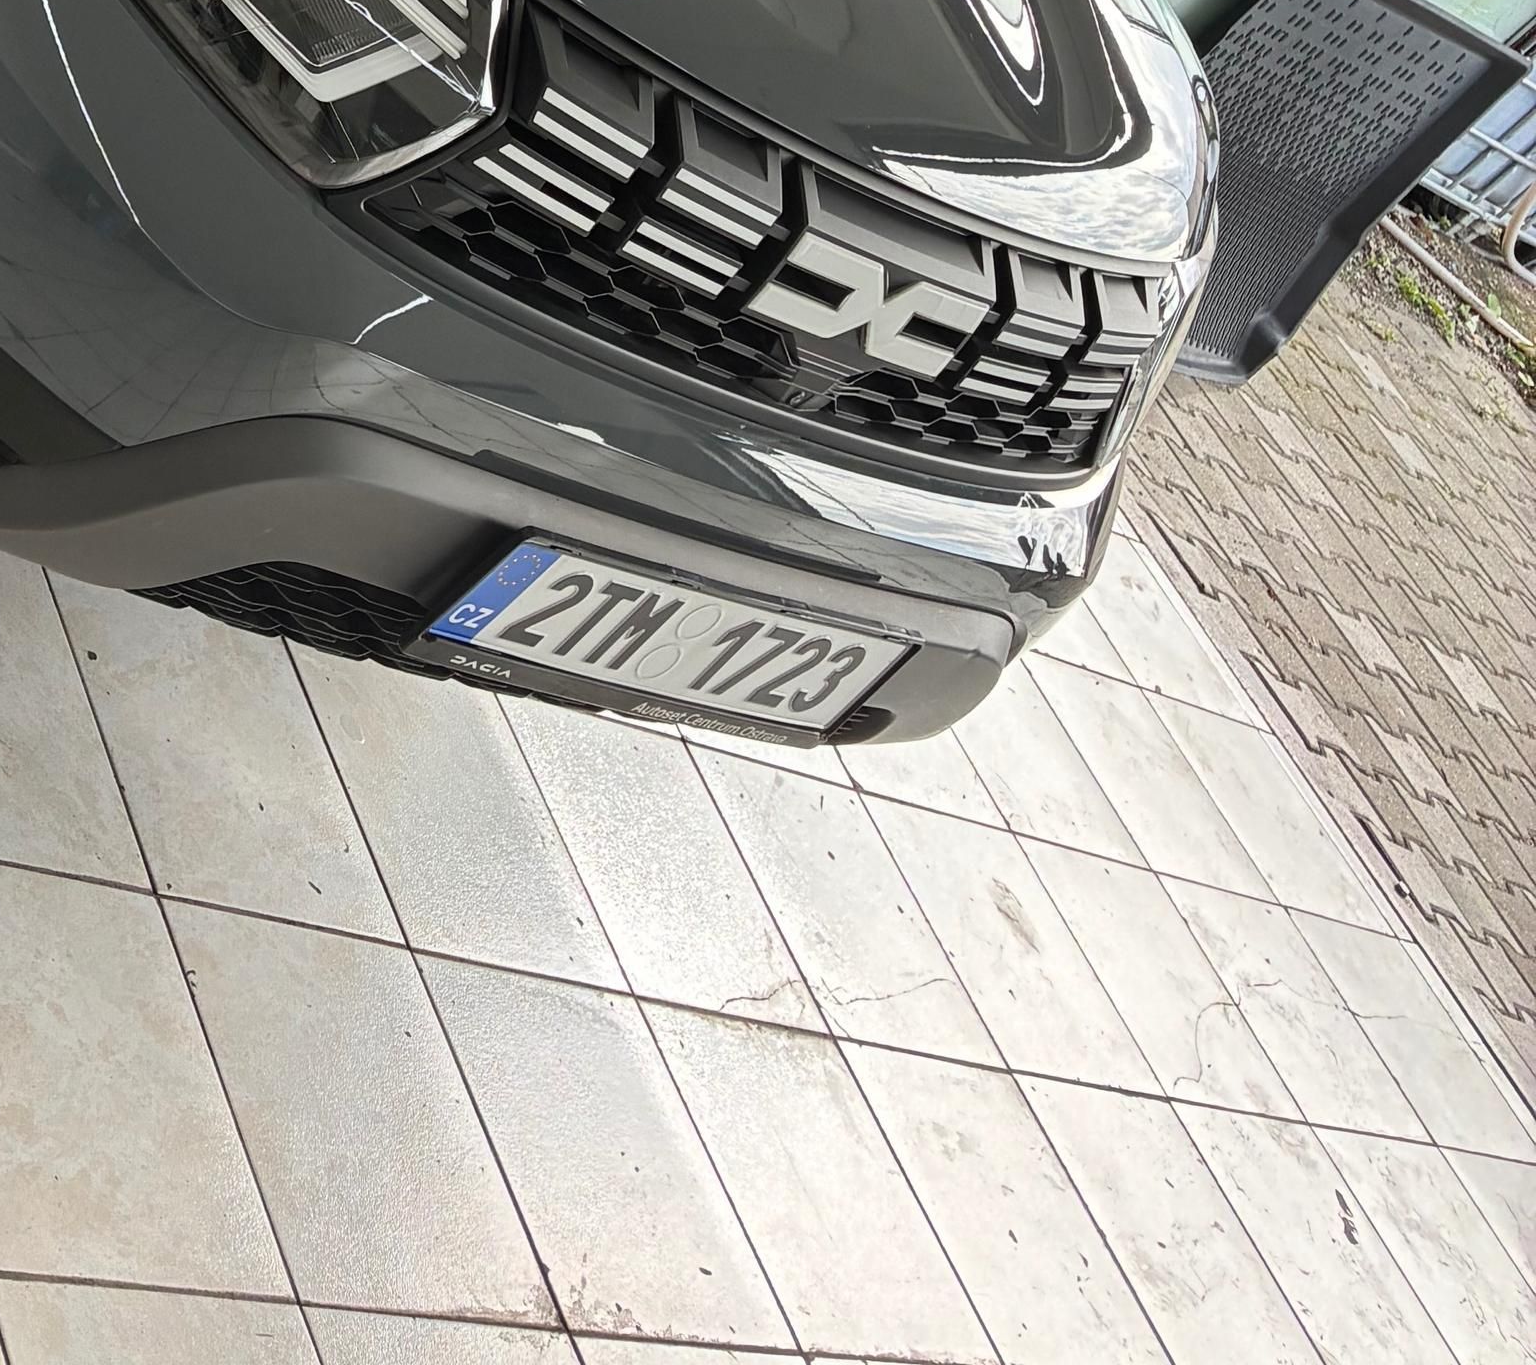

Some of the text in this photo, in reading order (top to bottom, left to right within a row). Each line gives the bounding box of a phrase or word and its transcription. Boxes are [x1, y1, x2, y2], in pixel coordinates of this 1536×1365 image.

[447, 601, 495, 630] CZ
[500, 572, 869, 714] 2TM 1723
[449, 654, 512, 680] DACIA
[631, 701, 685, 723] Autoset
[683, 712, 741, 735] Centrum
